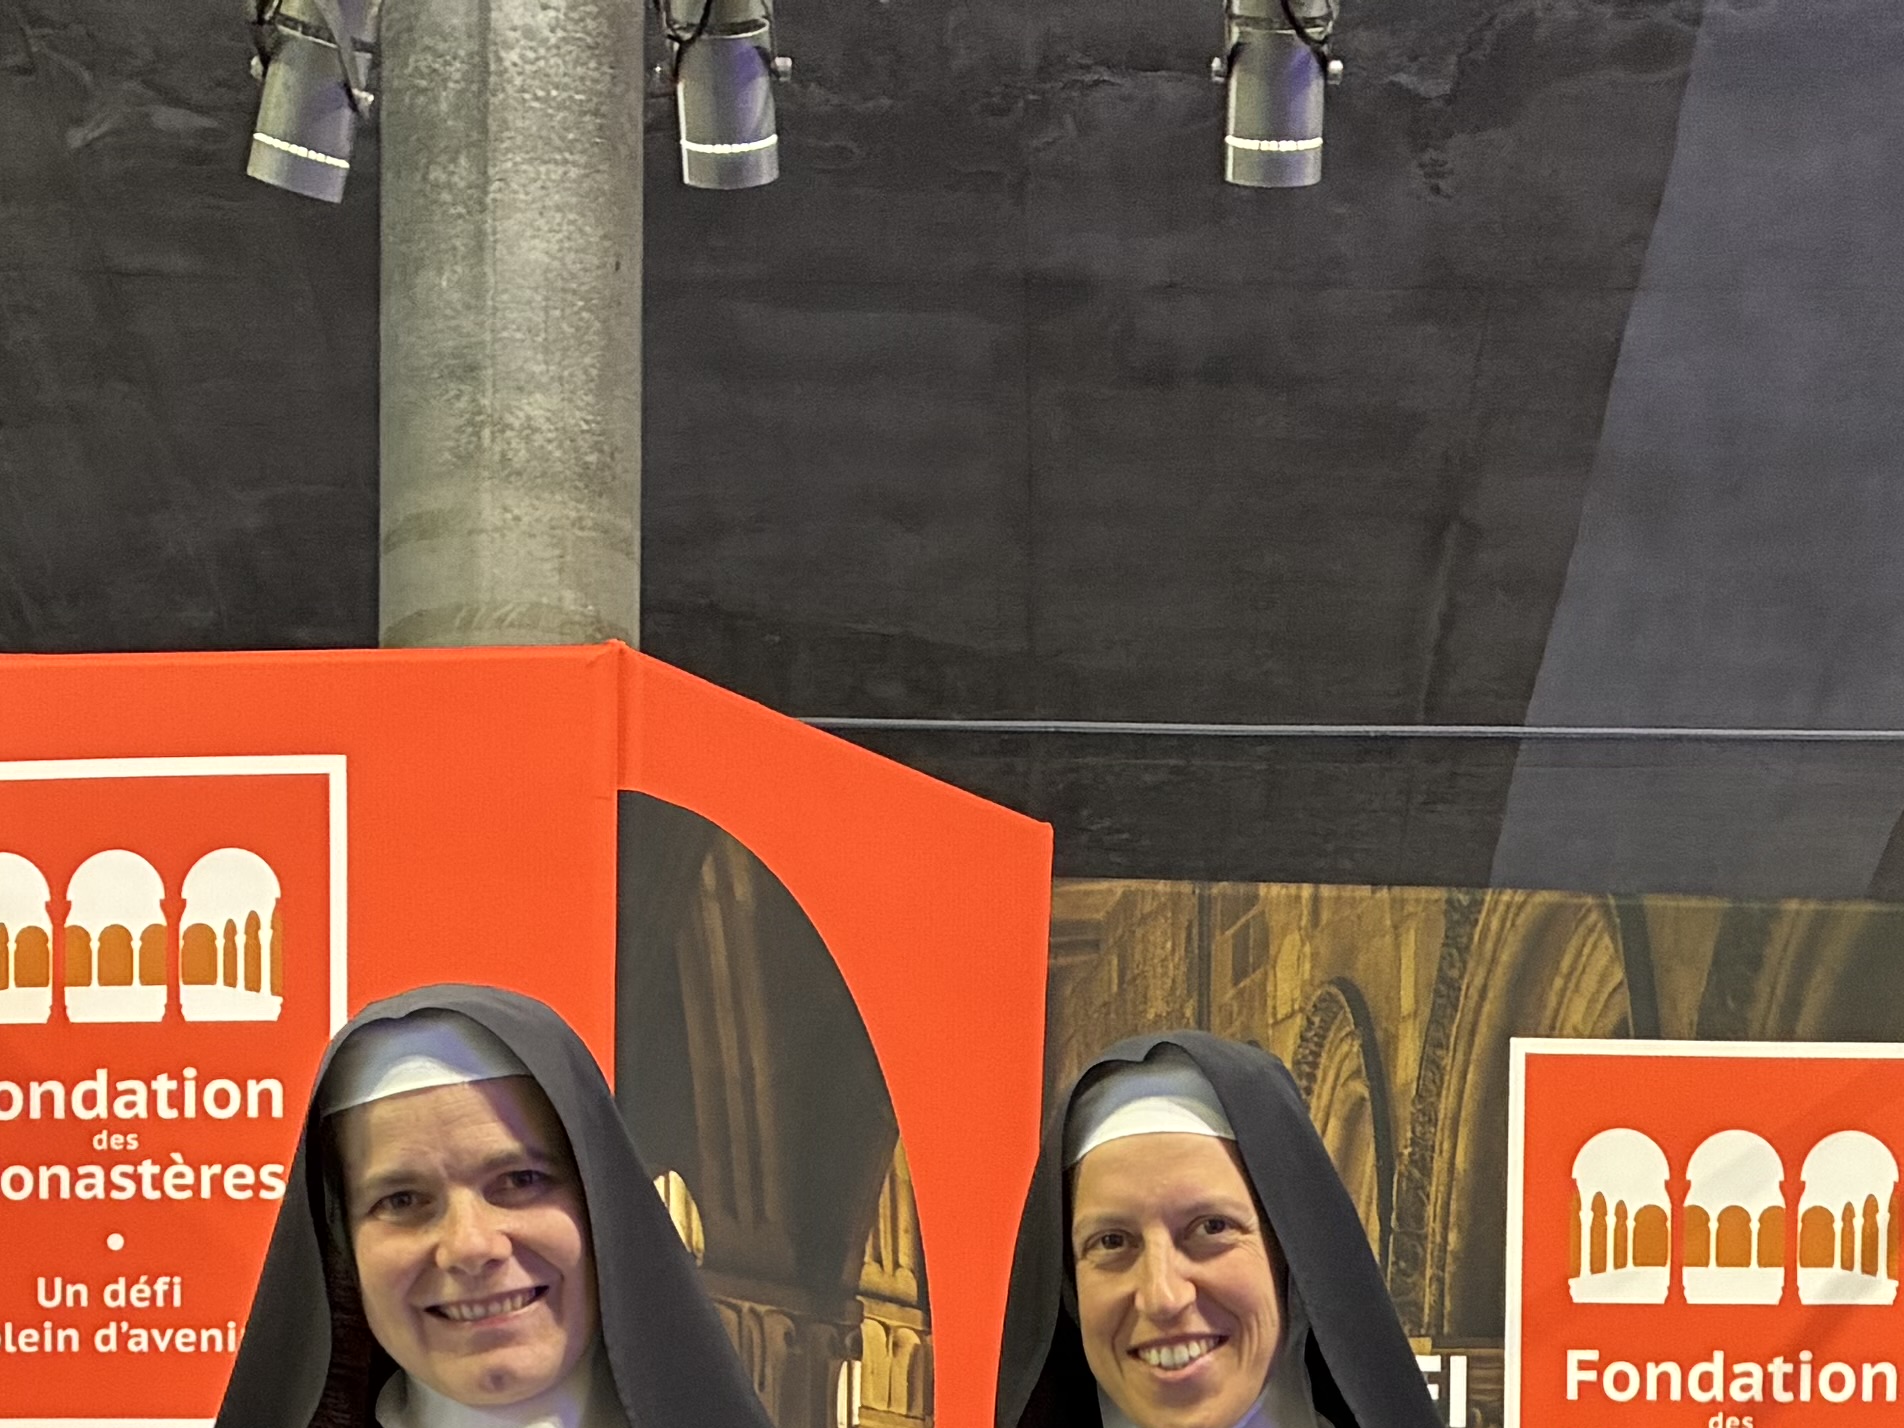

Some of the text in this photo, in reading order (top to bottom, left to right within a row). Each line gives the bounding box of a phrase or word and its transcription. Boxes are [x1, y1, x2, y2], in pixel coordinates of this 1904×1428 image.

[91, 1129, 140, 1151] des
[36, 1275, 183, 1308] Un défi
[93, 1320, 243, 1353] d’aveni
[1565, 1350, 1900, 1403] Fondation
